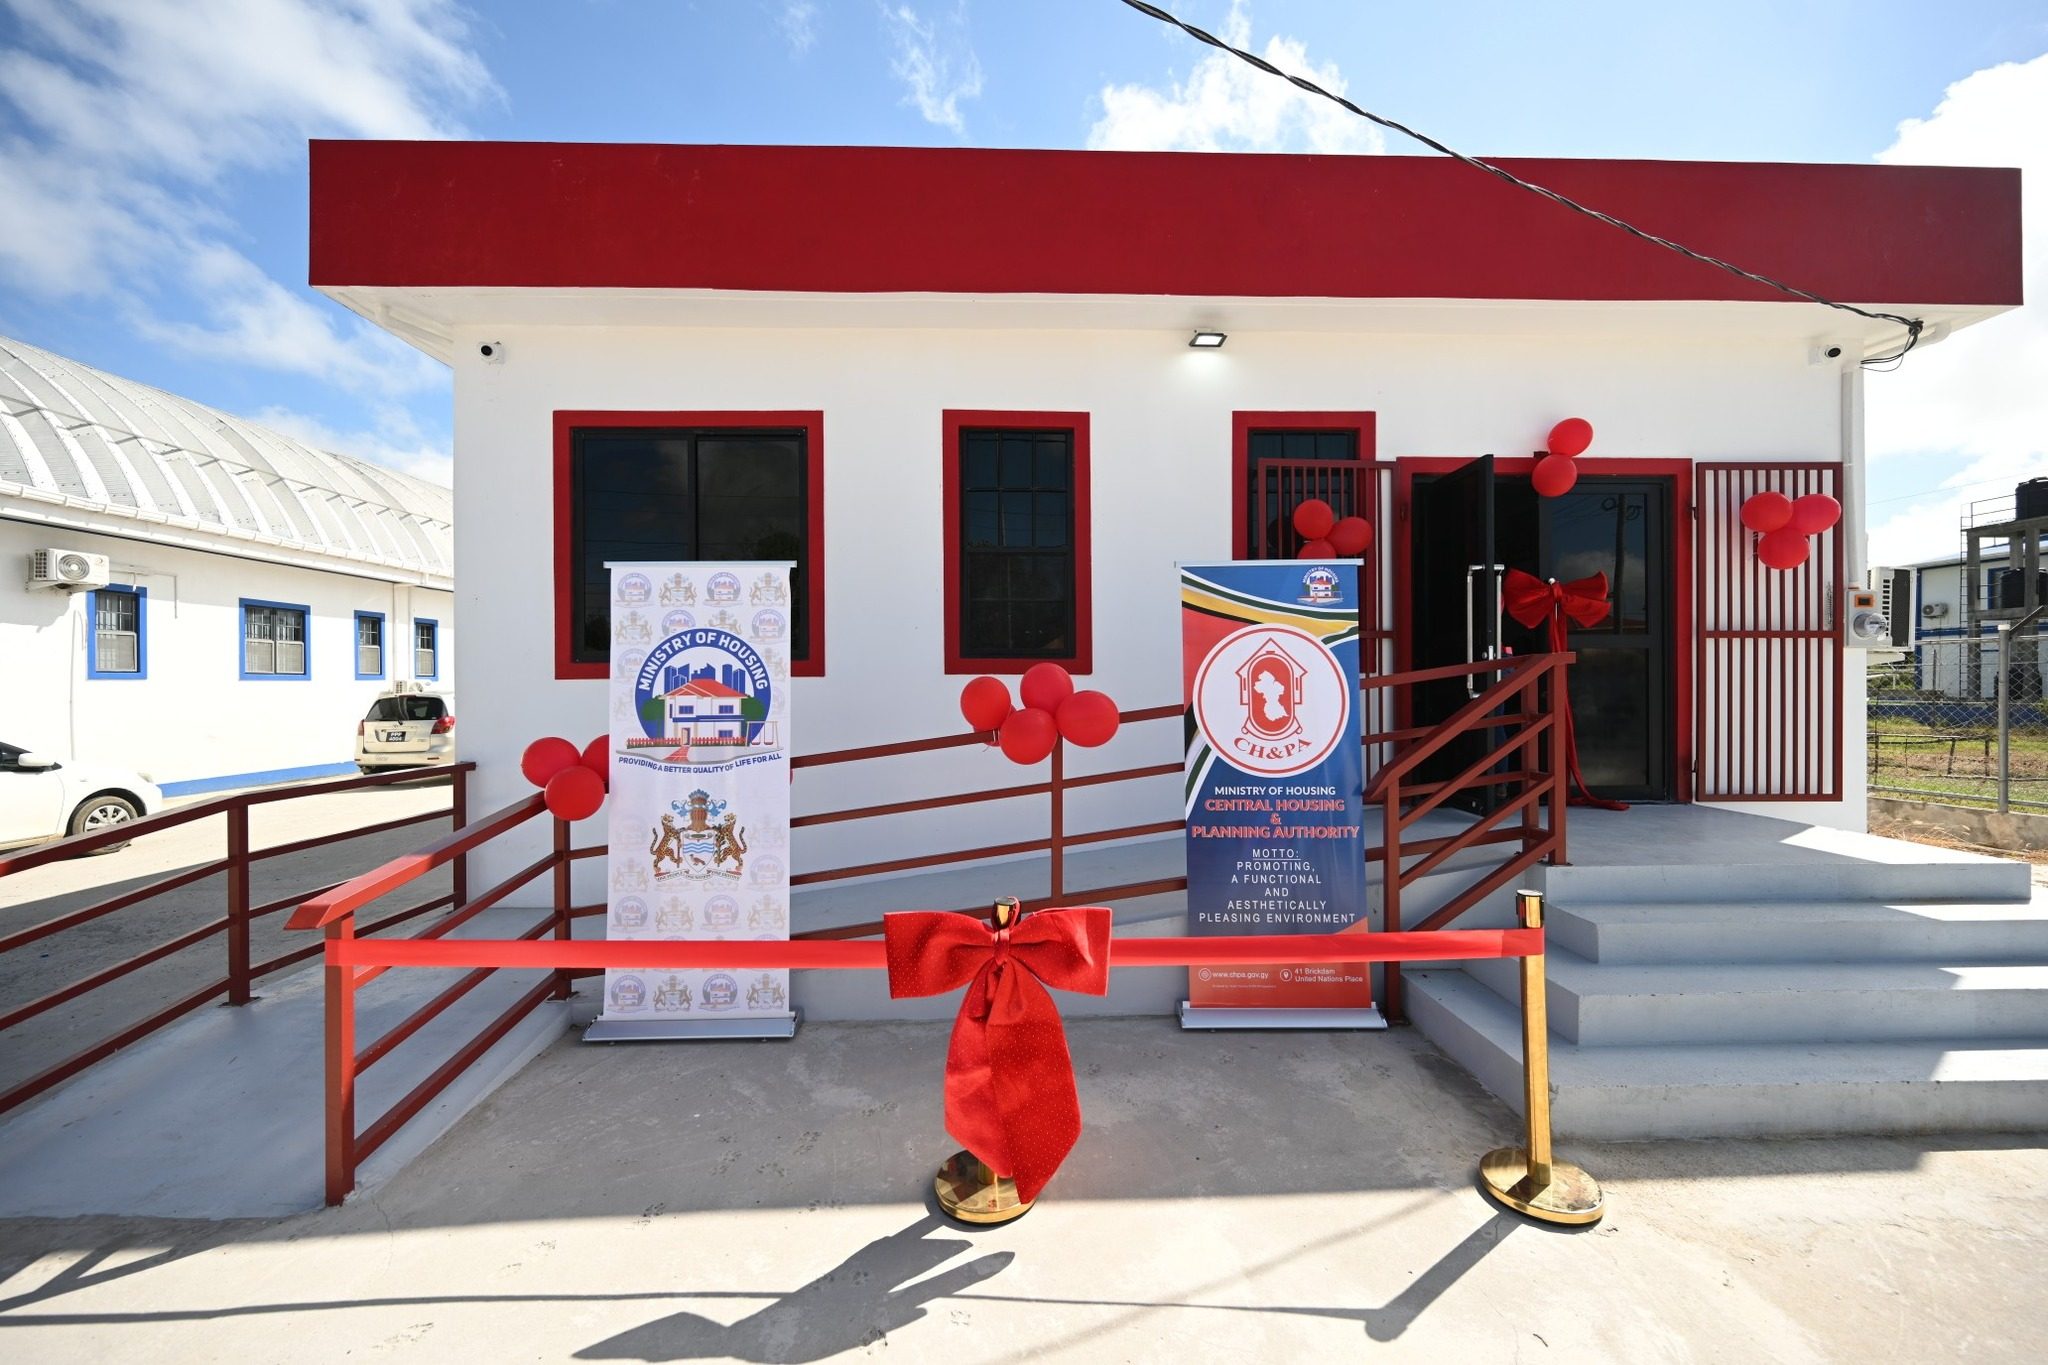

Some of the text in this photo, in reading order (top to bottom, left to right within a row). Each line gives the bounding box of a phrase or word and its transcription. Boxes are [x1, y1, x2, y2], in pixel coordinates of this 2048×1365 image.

[639, 631, 768, 691] MINISTRY OF HOUSING
[1234, 736, 1312, 759] CH&PA
[619, 757, 657, 770] PROVIDING
[657, 764, 663, 772] A
[735, 758, 751, 767] LIFE
[752, 756, 767, 764] FOR
[768, 753, 781, 762] ALL
[1215, 787, 1336, 795] MINISTRY OF HOUSING
[1204, 799, 1344, 811] CENTRAL HOUSING
[1270, 813, 1281, 825] &
[1192, 826, 1360, 838] PLANNING AUTHORITY
[1253, 849, 1299, 858] MOTTO:
[1237, 862, 1315, 872] PROMOTING,
[1231, 875, 1321, 884] A FUNCTIONAL
[1264, 888, 1289, 896] AND
[1228, 900, 1327, 910] AESTHETICALLY
[1200, 913, 1355, 923] PLEASING ENVIRONMENT
